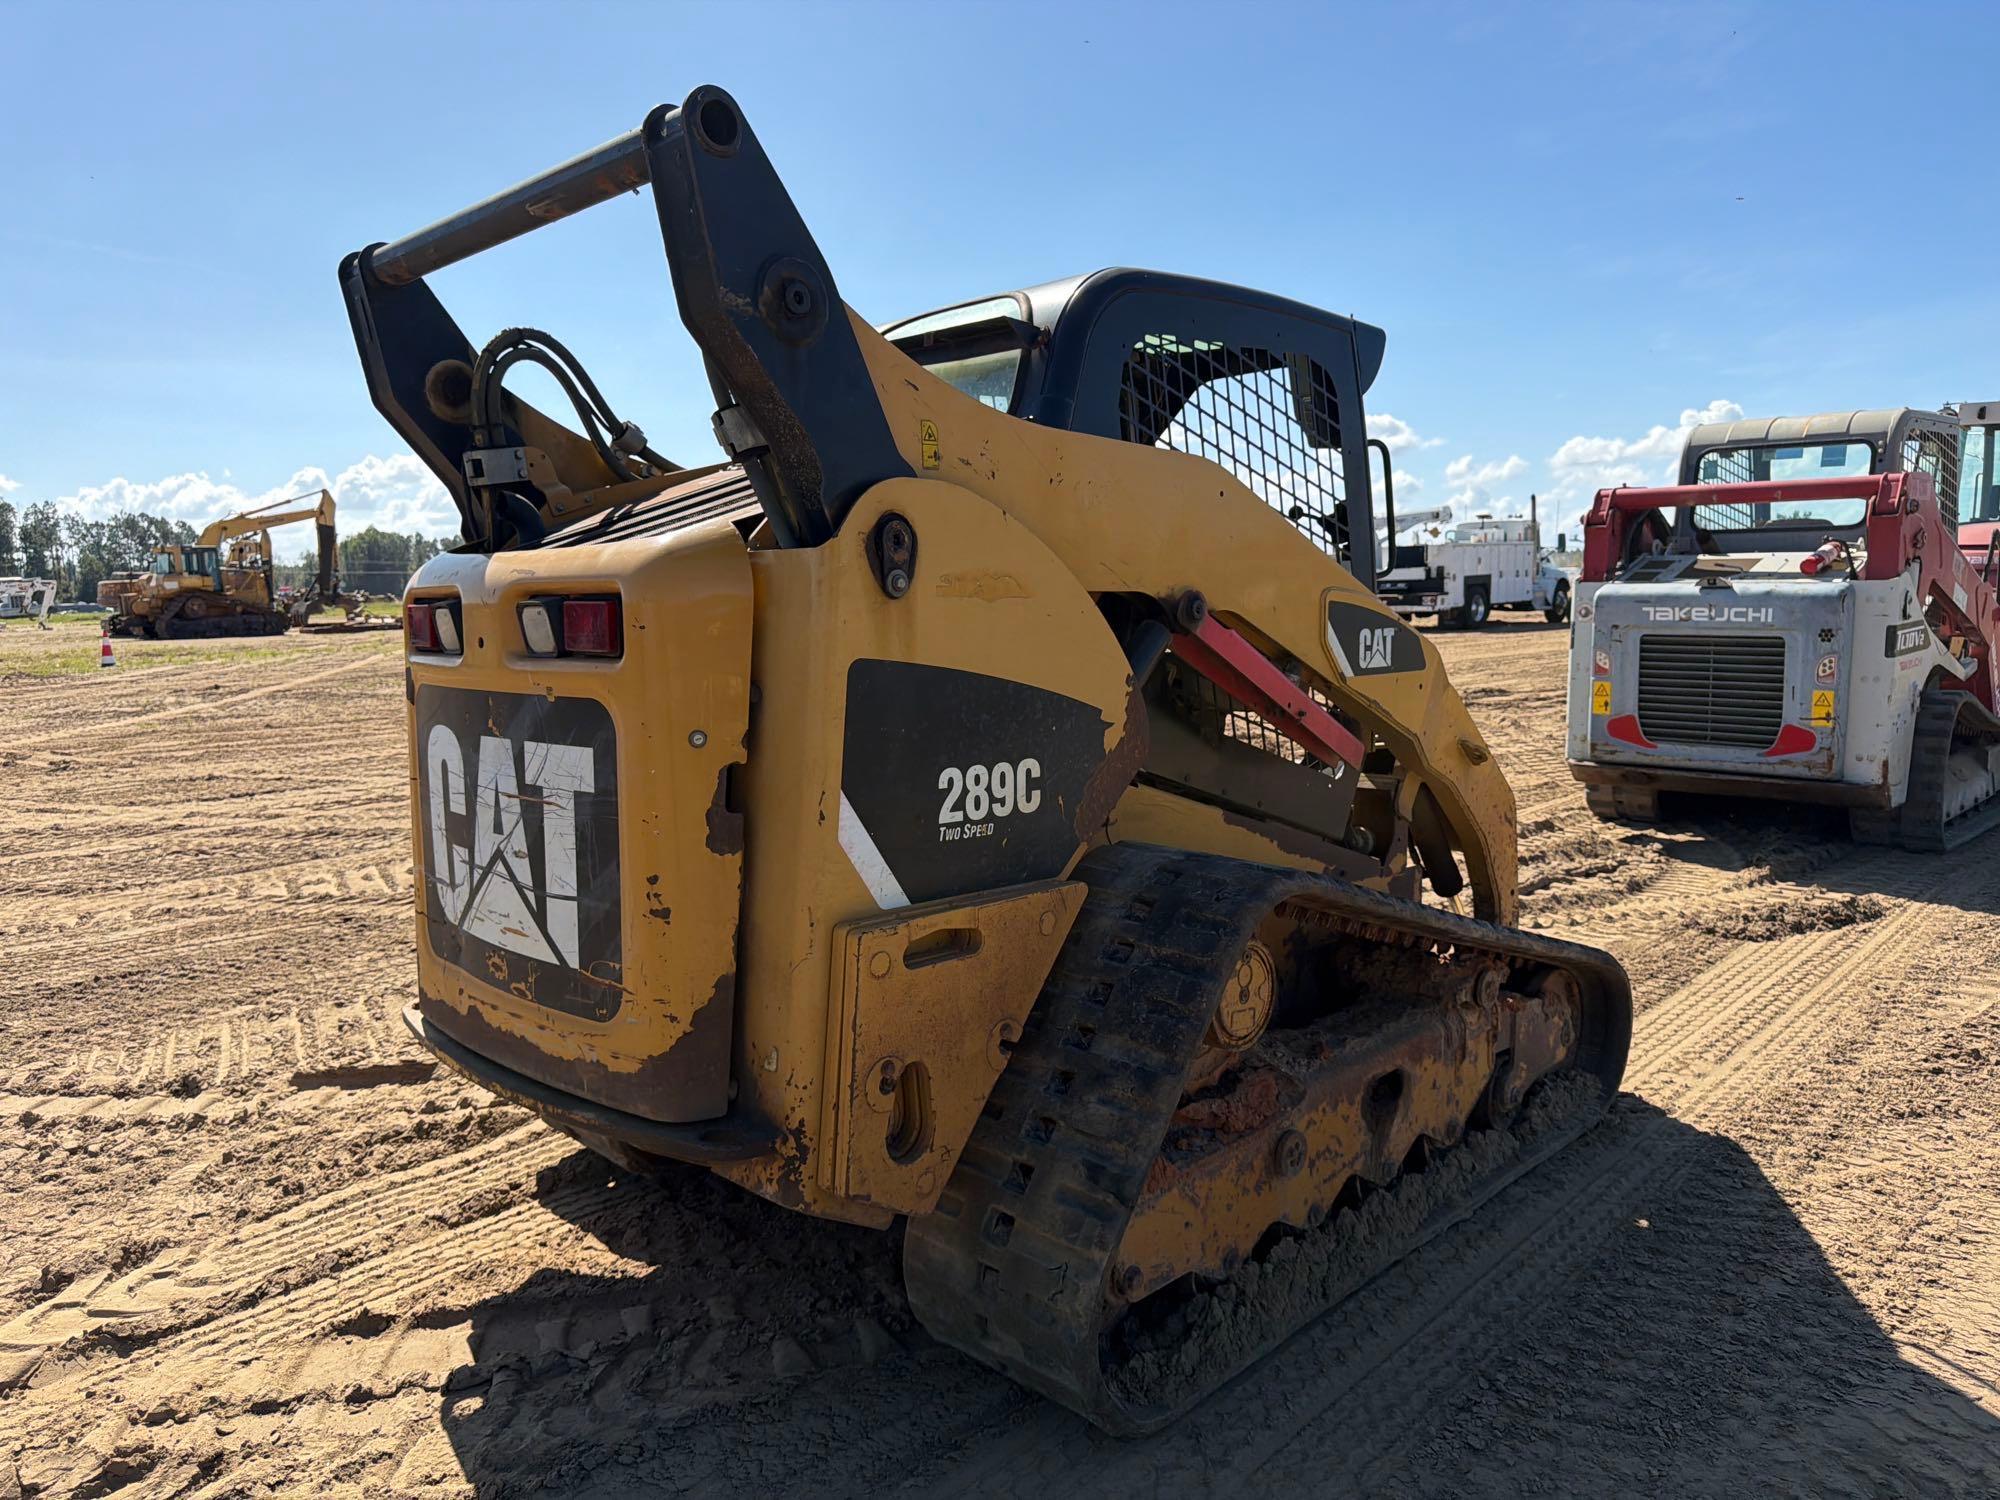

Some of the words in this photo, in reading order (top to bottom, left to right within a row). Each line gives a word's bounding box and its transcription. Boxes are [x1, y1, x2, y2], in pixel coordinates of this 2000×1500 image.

[1359, 627, 1395, 669] CAT
[938, 758, 1041, 824] 289C
[428, 724, 595, 970] CAT
